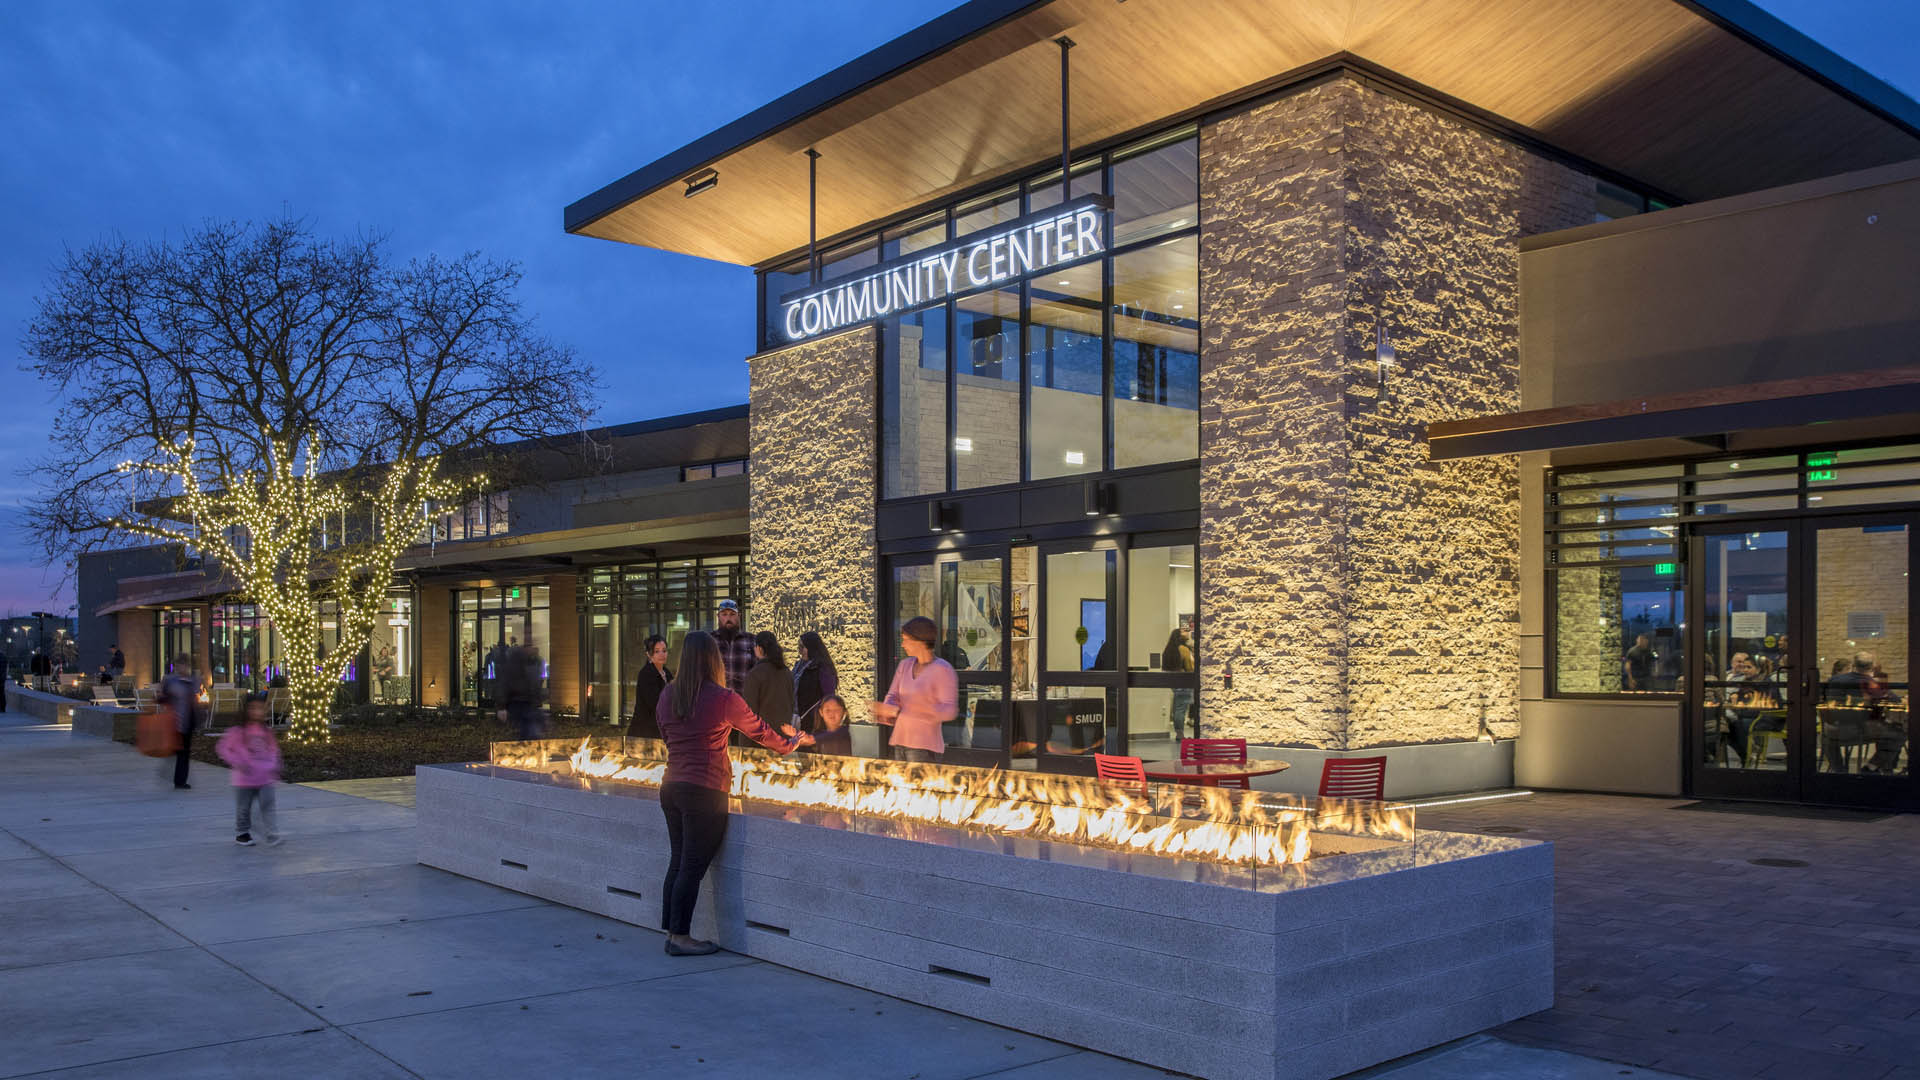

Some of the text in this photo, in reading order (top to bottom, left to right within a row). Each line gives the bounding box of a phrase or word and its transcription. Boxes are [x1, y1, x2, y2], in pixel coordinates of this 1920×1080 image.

[785, 209, 1103, 340] COMMUNITY CENTER
[1075, 713, 1103, 725] SMUD
